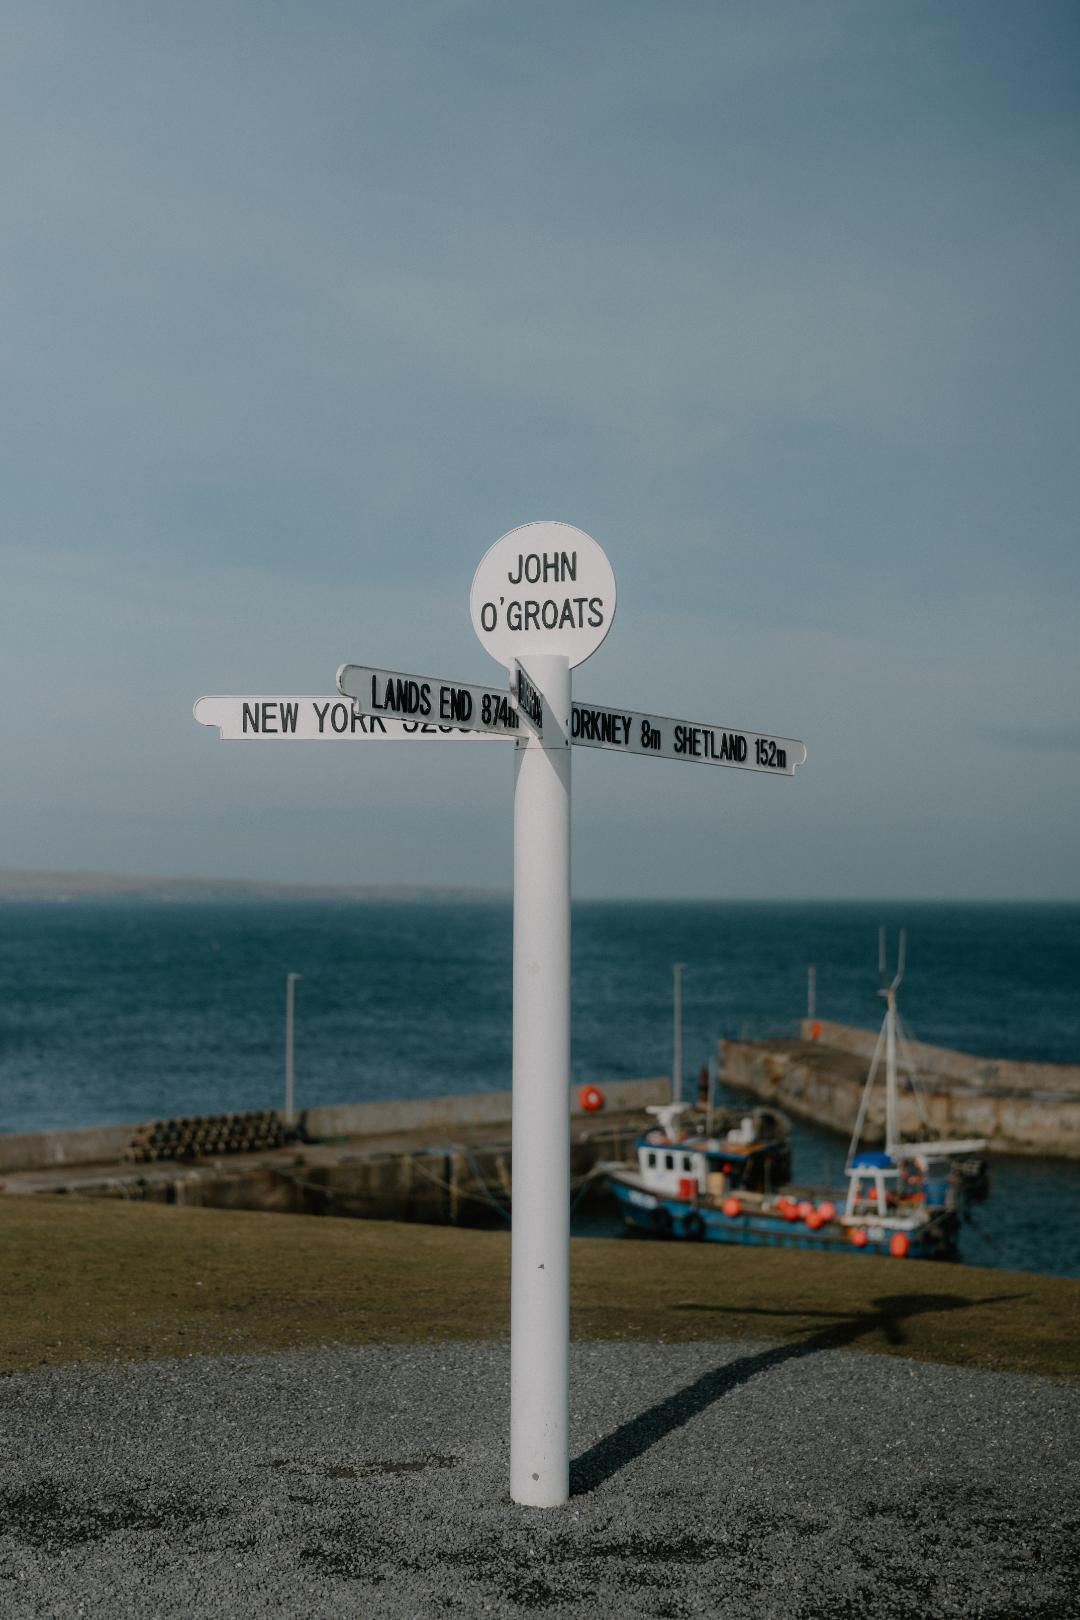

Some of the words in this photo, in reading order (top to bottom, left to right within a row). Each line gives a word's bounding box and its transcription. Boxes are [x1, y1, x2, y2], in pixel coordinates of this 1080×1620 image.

[508, 551, 577, 585] JOHN
[481, 597, 604, 632] O'GROATS
[242, 702, 299, 733] NEW
[371, 674, 431, 716] LANDS
[439, 686, 472, 721] END
[481, 694, 519, 729] 874m
[640, 720, 661, 750] 8m
[674, 725, 747, 763] SHETLAND
[755, 738, 787, 769] 152m
